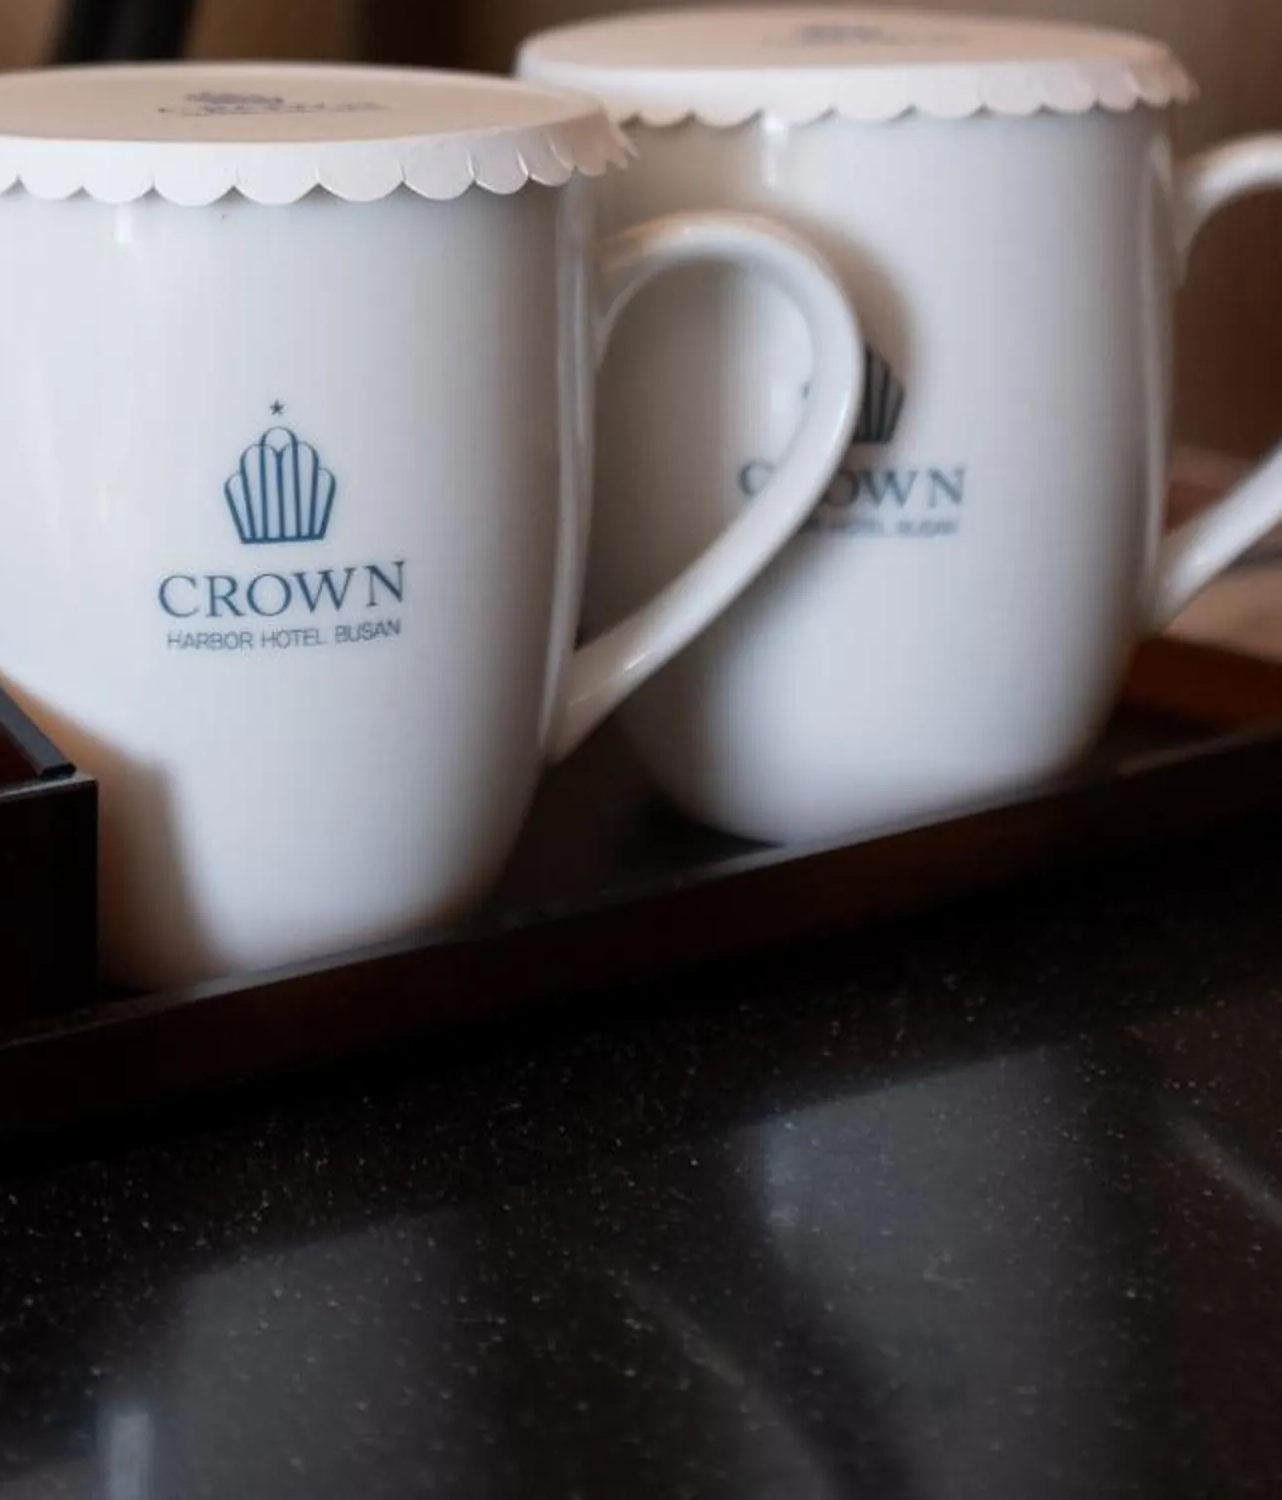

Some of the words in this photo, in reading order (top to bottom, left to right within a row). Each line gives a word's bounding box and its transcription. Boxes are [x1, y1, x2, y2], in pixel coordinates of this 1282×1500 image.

[737, 459, 966, 509] COWN
[158, 559, 406, 618] CROWN
[167, 629, 253, 651] HARBOR
[261, 627, 324, 648] HOTEL
[334, 617, 401, 642] BUSAN
